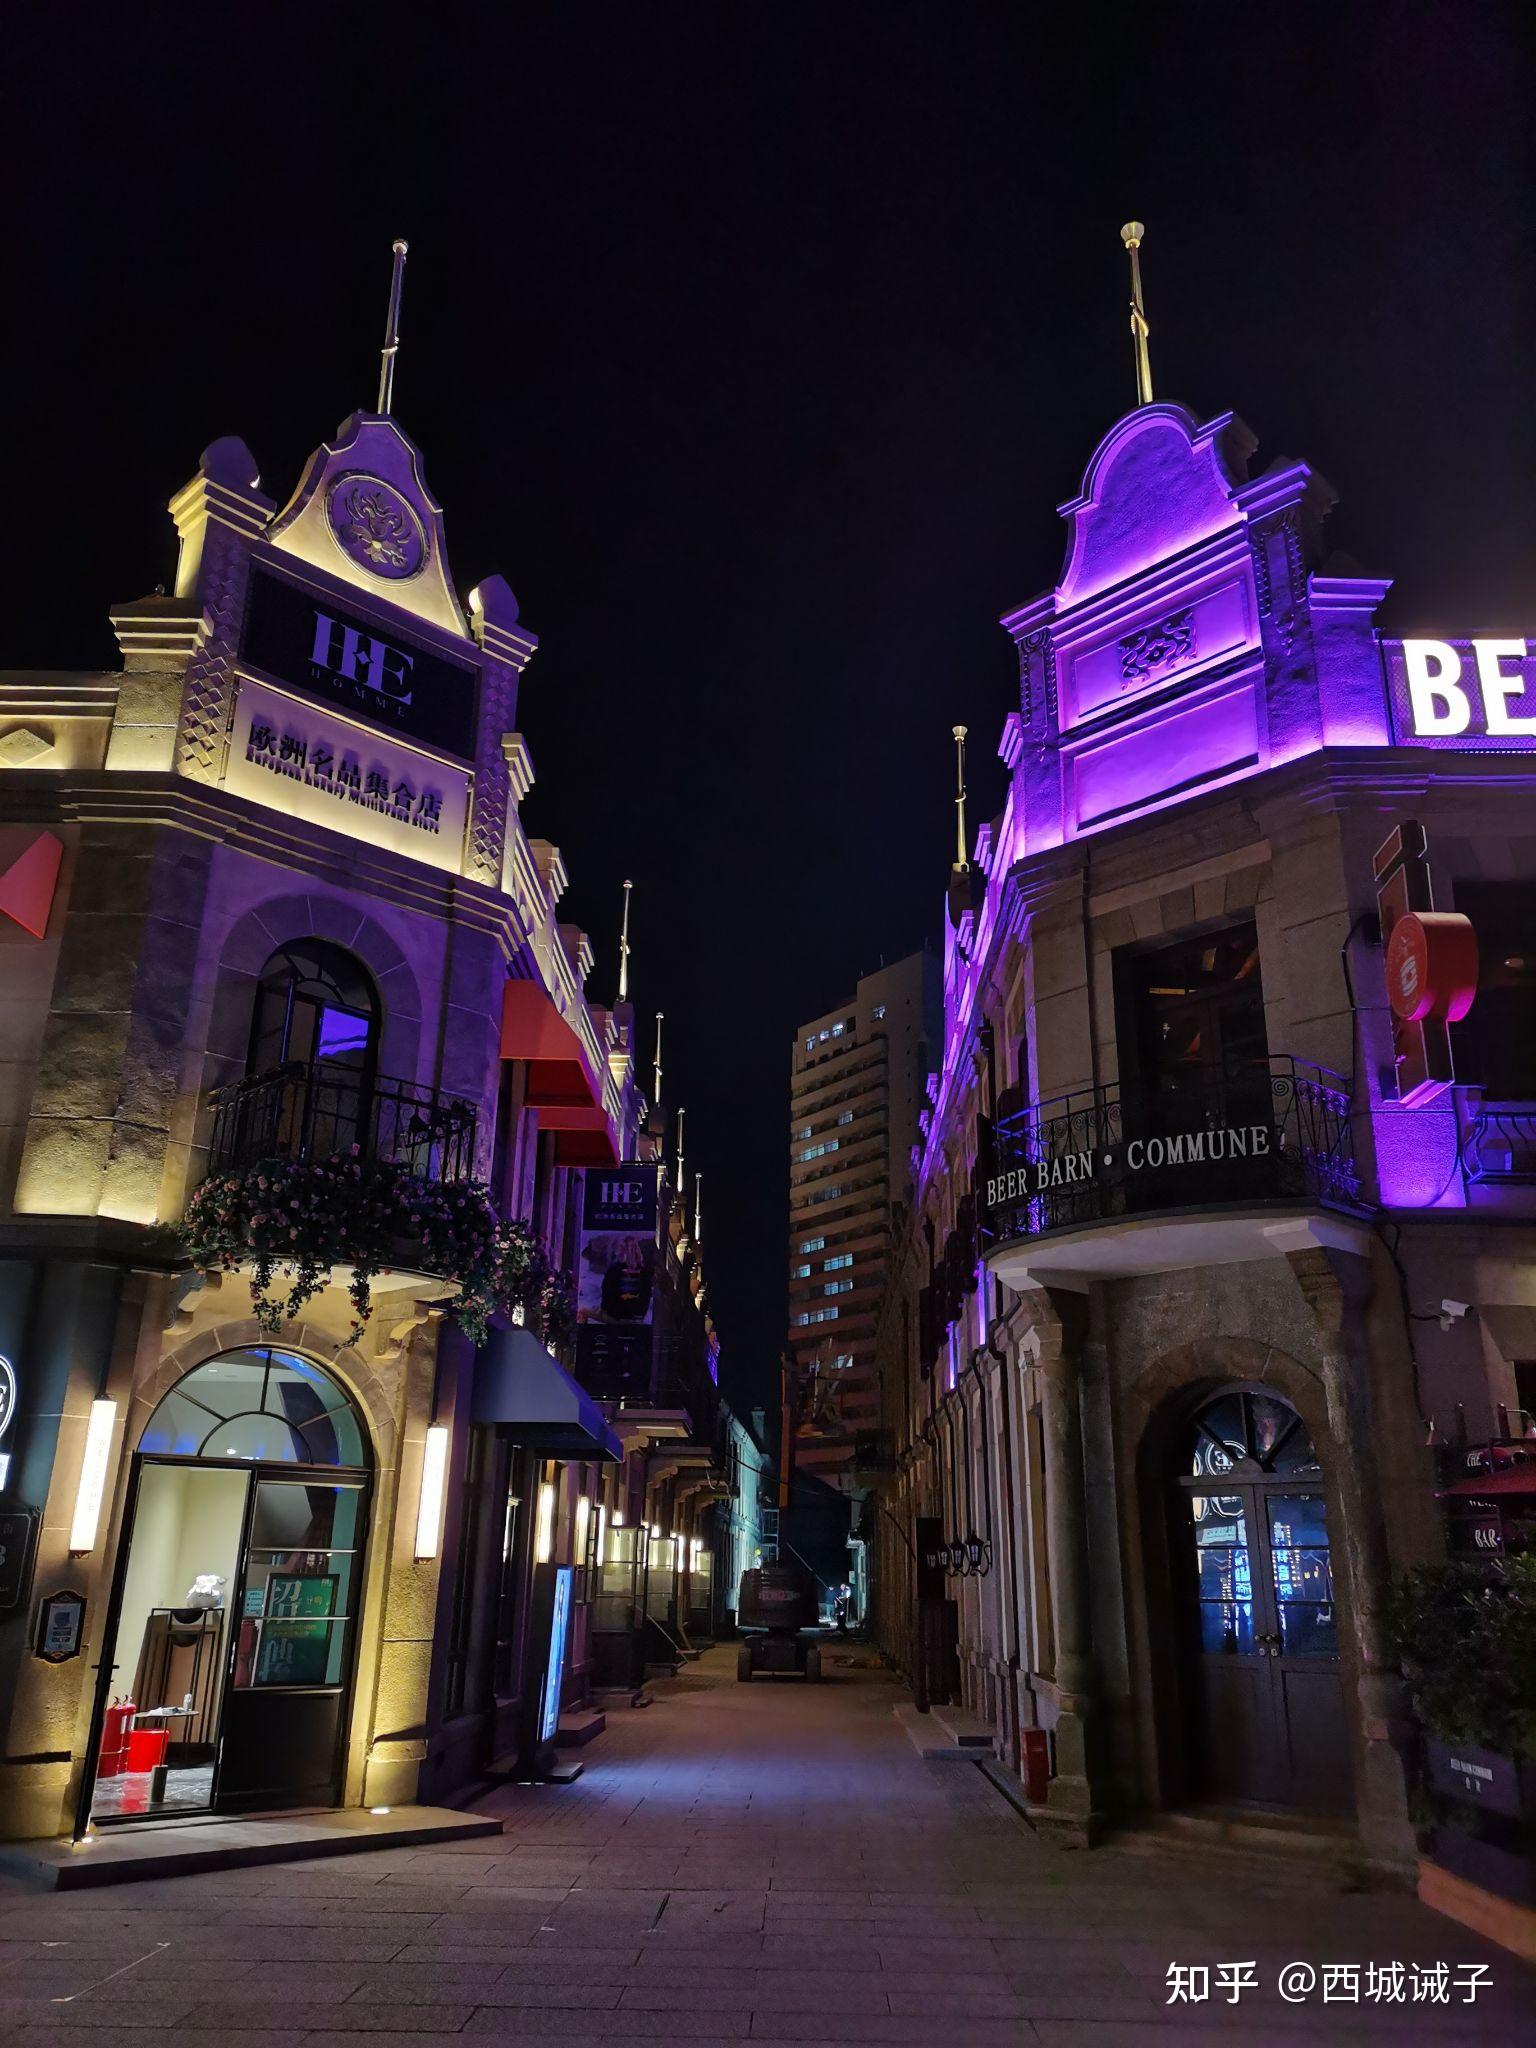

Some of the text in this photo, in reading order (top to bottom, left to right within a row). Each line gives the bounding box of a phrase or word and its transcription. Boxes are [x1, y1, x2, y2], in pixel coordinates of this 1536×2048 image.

[311, 667, 406, 717] HOMME
[248, 721, 443, 822] 欧洲名品集合店
[986, 1124, 1270, 1207] BEER BARN COMMUNE
[1475, 1529, 1498, 1548] BAR
